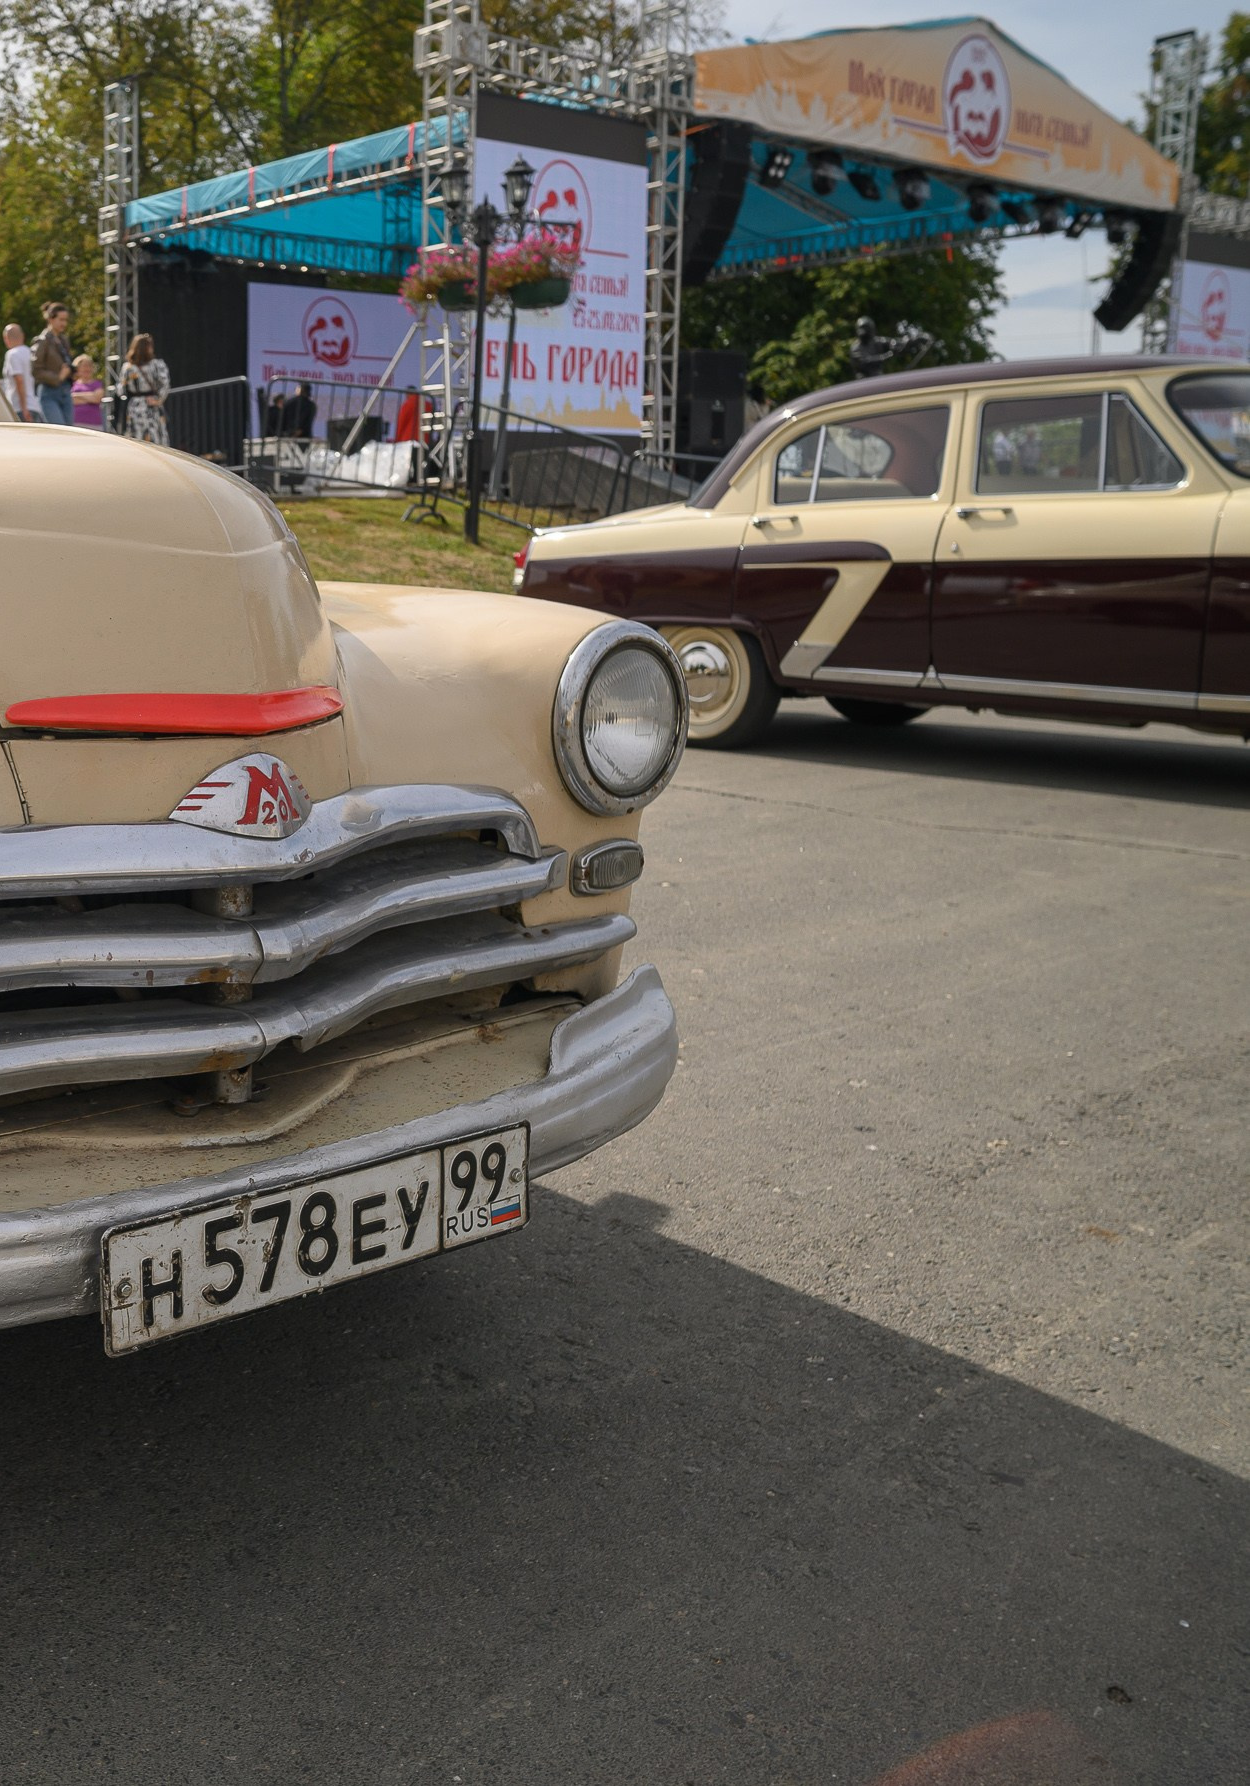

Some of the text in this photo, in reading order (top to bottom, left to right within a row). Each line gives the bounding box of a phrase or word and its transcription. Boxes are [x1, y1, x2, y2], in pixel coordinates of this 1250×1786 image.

[472, 330, 638, 392] ЕНЬ ГОРОДА
[450, 1141, 507, 1213] 99
[446, 1206, 489, 1239] RUS
